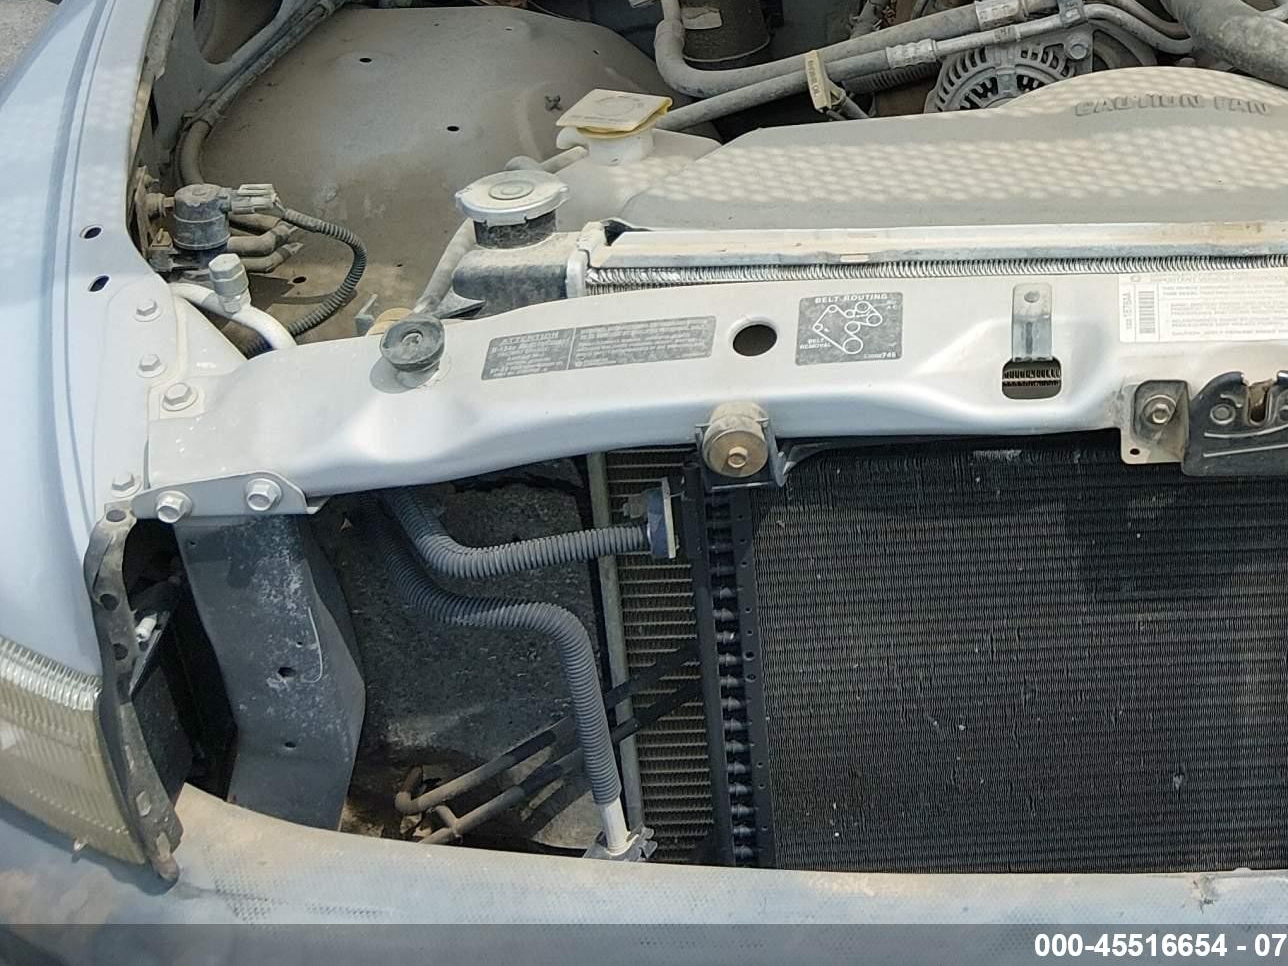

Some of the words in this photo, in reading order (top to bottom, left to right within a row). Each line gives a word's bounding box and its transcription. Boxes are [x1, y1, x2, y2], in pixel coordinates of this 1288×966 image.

[1075, 93, 1202, 117] CAUTION
[1213, 95, 1272, 116] FAN
[844, 293, 888, 301] ROUTING
